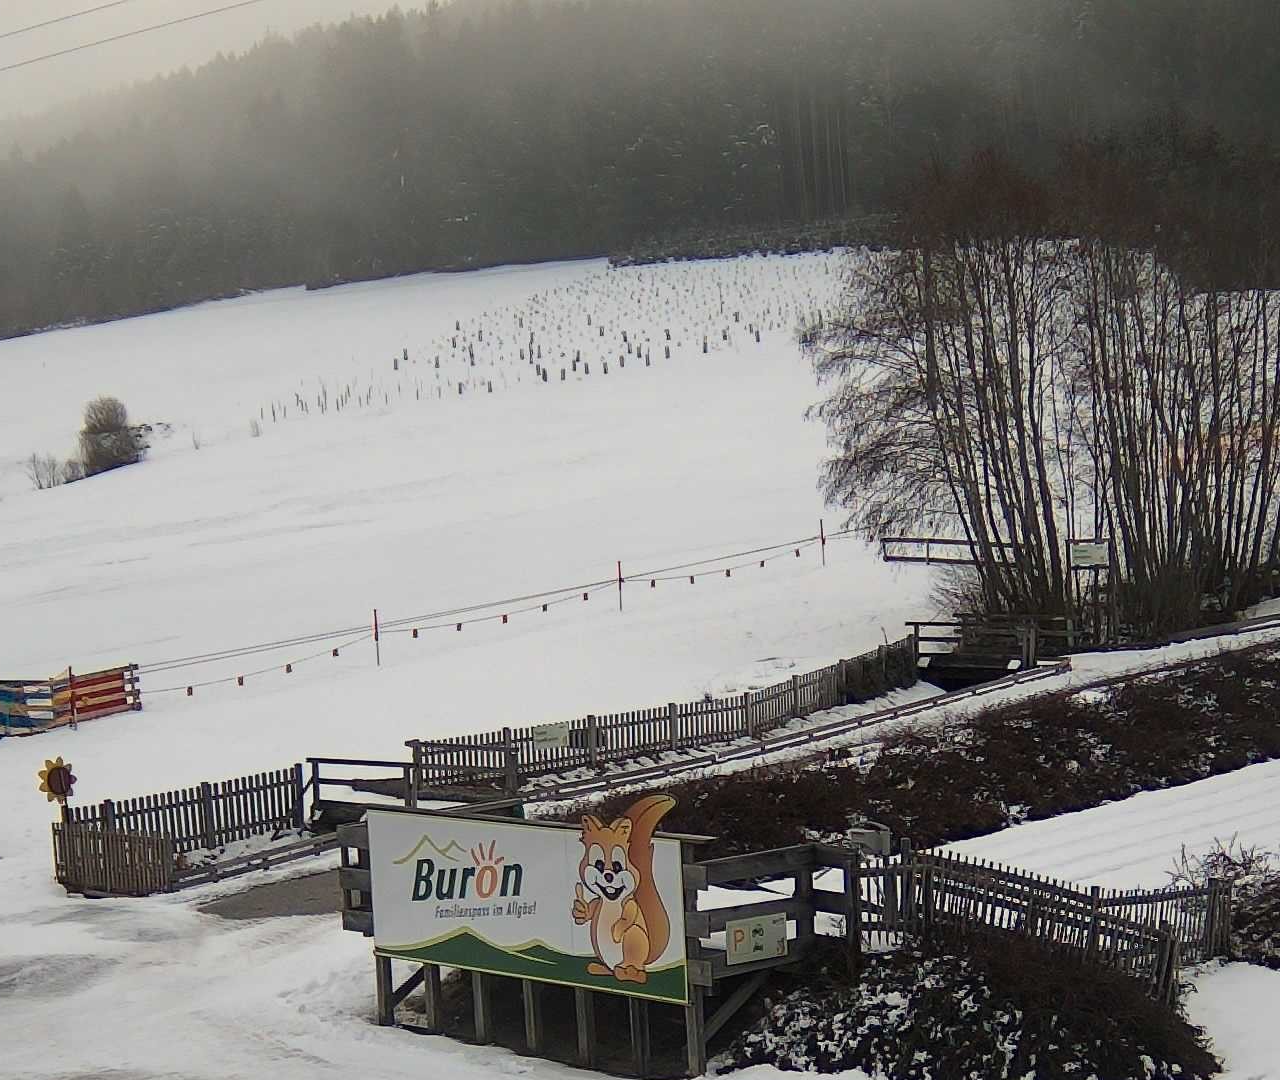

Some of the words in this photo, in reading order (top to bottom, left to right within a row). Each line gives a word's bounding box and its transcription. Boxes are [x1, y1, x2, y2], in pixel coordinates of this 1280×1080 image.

[412, 858, 523, 901] Buron
[493, 905, 504, 918] im
[733, 928, 746, 953] P
